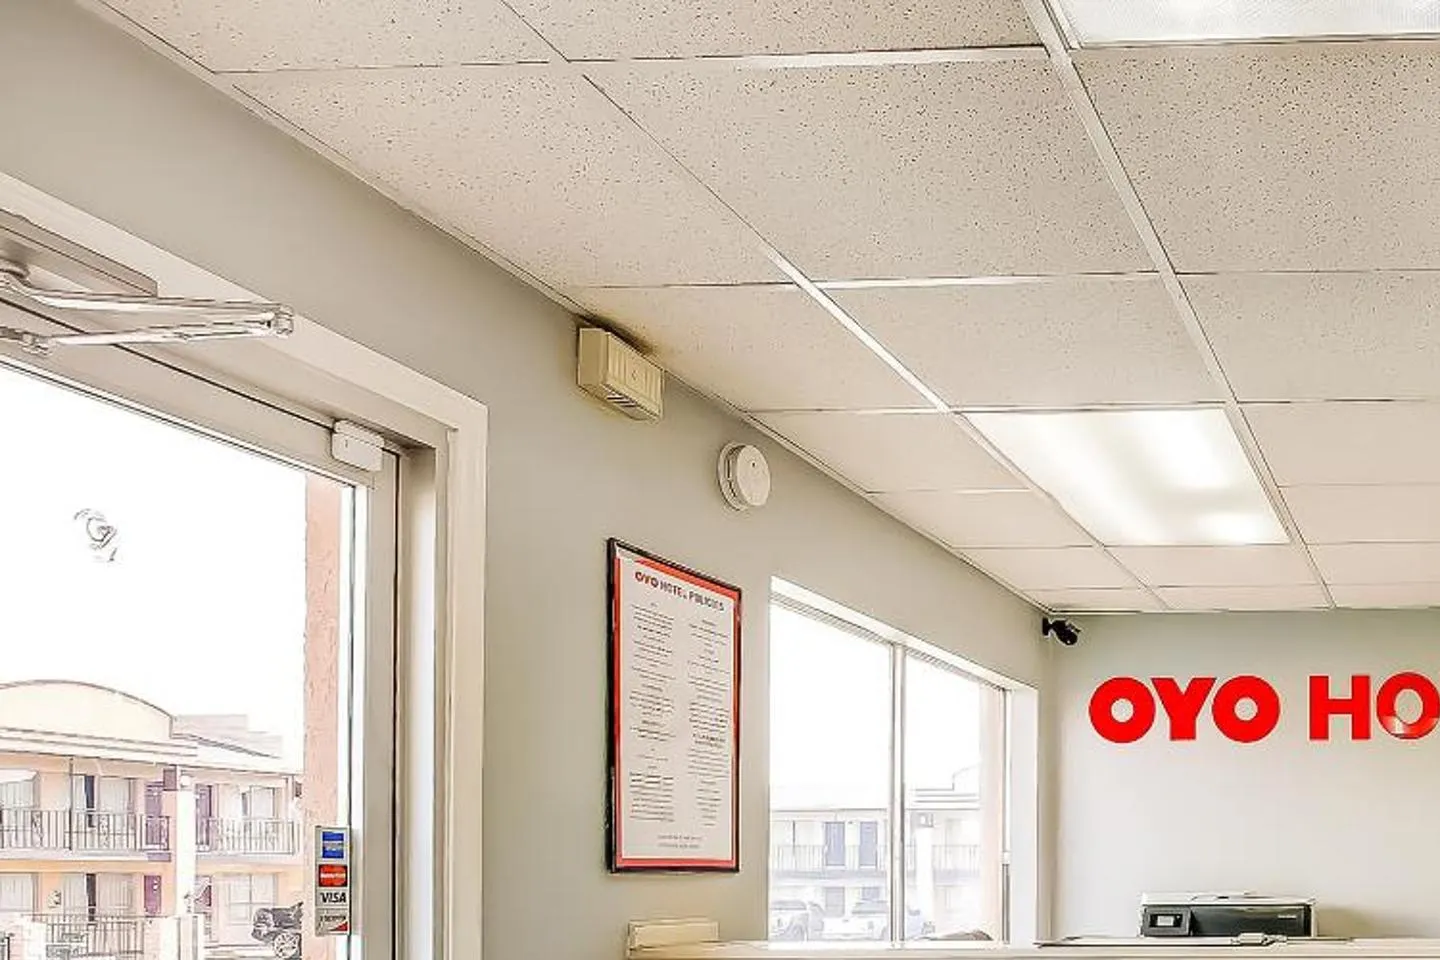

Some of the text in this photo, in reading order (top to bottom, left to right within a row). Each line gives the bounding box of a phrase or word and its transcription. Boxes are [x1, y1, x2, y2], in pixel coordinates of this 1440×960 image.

[634, 570, 659, 589] OYO
[1088, 675, 1281, 744] OYO
[320, 892, 347, 903] VISA
